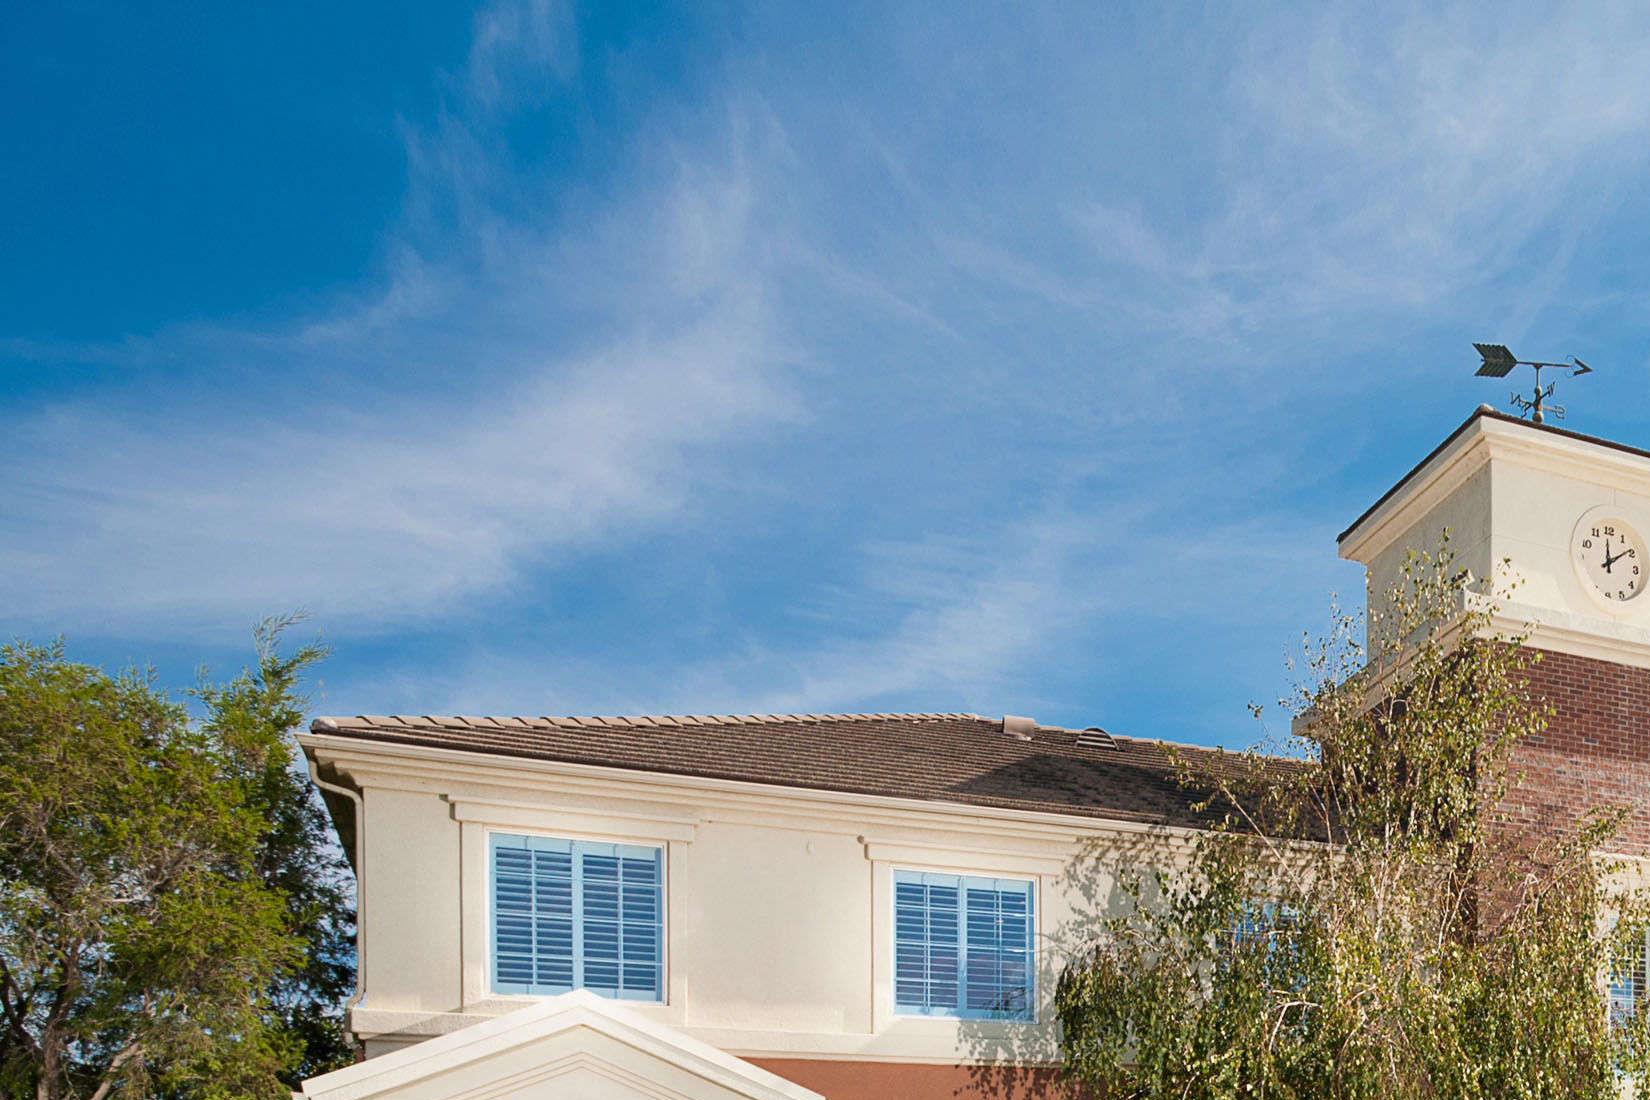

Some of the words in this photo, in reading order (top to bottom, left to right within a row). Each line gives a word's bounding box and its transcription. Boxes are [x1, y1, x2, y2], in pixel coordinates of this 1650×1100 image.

[1591, 527, 1600, 538] 11
[1604, 526, 1615, 536] 12
[1582, 539, 1592, 549] 10
[1620, 534, 1625, 544] 1
[1628, 548, 1635, 558] 2
[1632, 565, 1639, 575] 3
